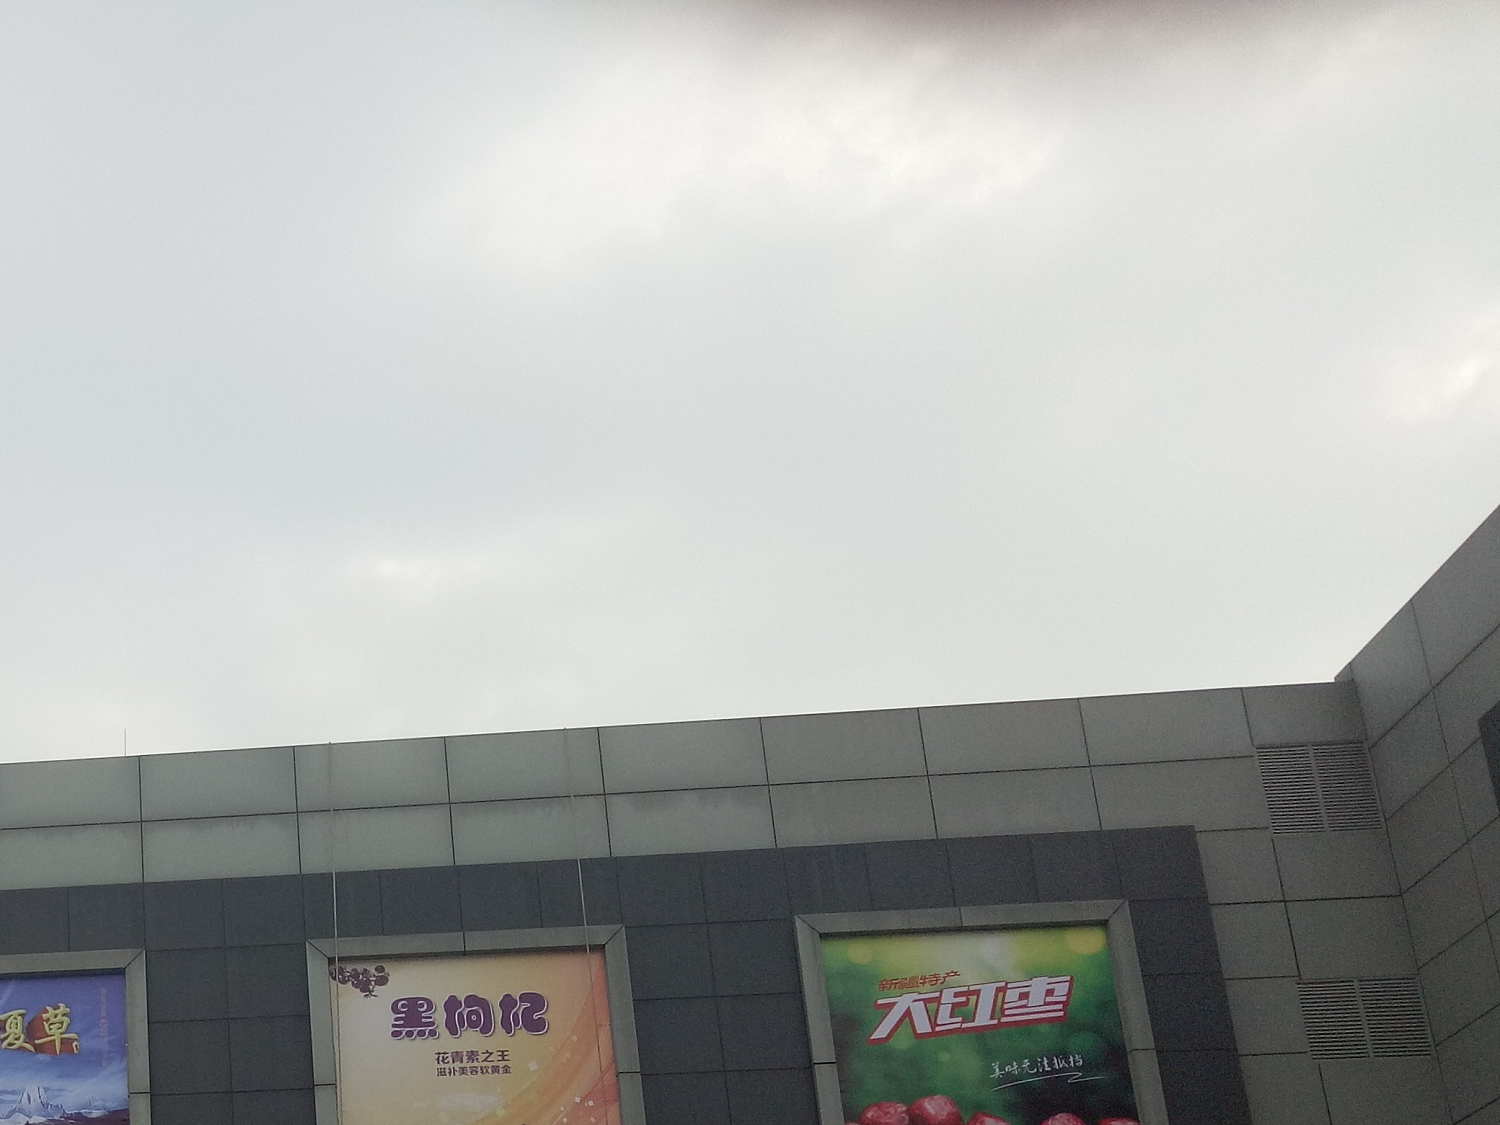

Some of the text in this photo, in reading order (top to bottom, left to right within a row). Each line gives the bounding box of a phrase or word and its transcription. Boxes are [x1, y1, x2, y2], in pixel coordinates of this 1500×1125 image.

[391, 991, 549, 1040] 黑枸杞
[866, 975, 1074, 1045] 大红枣
[435, 1050, 511, 1065] 花青素之王
[990, 1054, 1083, 1079] 美味无法抵挡
[436, 1065, 512, 1077] 滋补美容软黄金
